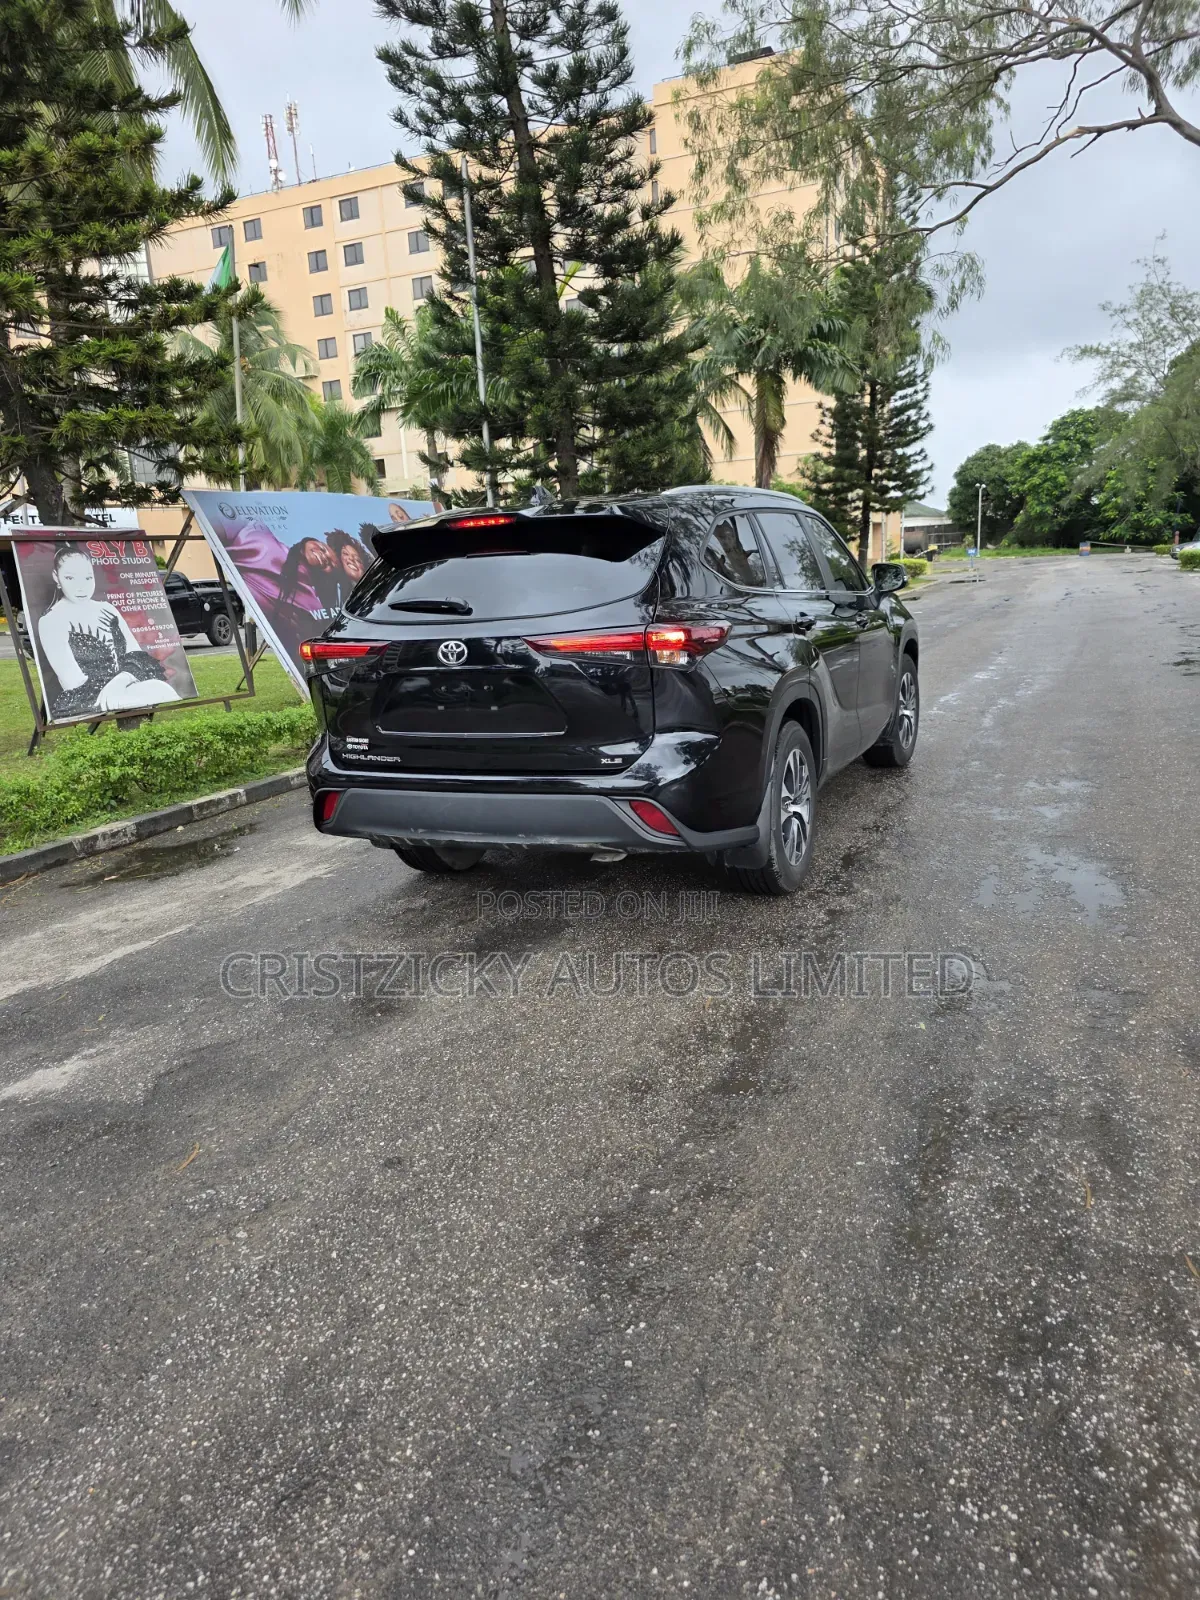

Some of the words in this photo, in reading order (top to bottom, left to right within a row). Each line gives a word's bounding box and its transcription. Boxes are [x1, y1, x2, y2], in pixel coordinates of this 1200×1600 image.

[235, 505, 289, 516] ELEVATION
[86, 540, 126, 558] SLY
[131, 540, 148, 557] B
[91, 558, 120, 566] PHOTO
[121, 556, 151, 565] STUDIO
[134, 571, 158, 579] MINUTE
[129, 577, 160, 585] PASSPORT
[106, 592, 125, 600] PRINT
[125, 591, 135, 599] OF
[135, 589, 164, 598] PICTURES
[111, 599, 126, 607] OUT
[126, 598, 136, 606] OF
[137, 597, 159, 605] PHONE
[120, 604, 142, 612] OTHER
[142, 602, 168, 611] DEVICES
[309, 608, 330, 621] WE
[352, 743, 369, 751] TOYOTA
[341, 753, 402, 763] HIGHLANDER
[600, 757, 623, 765] XLE
